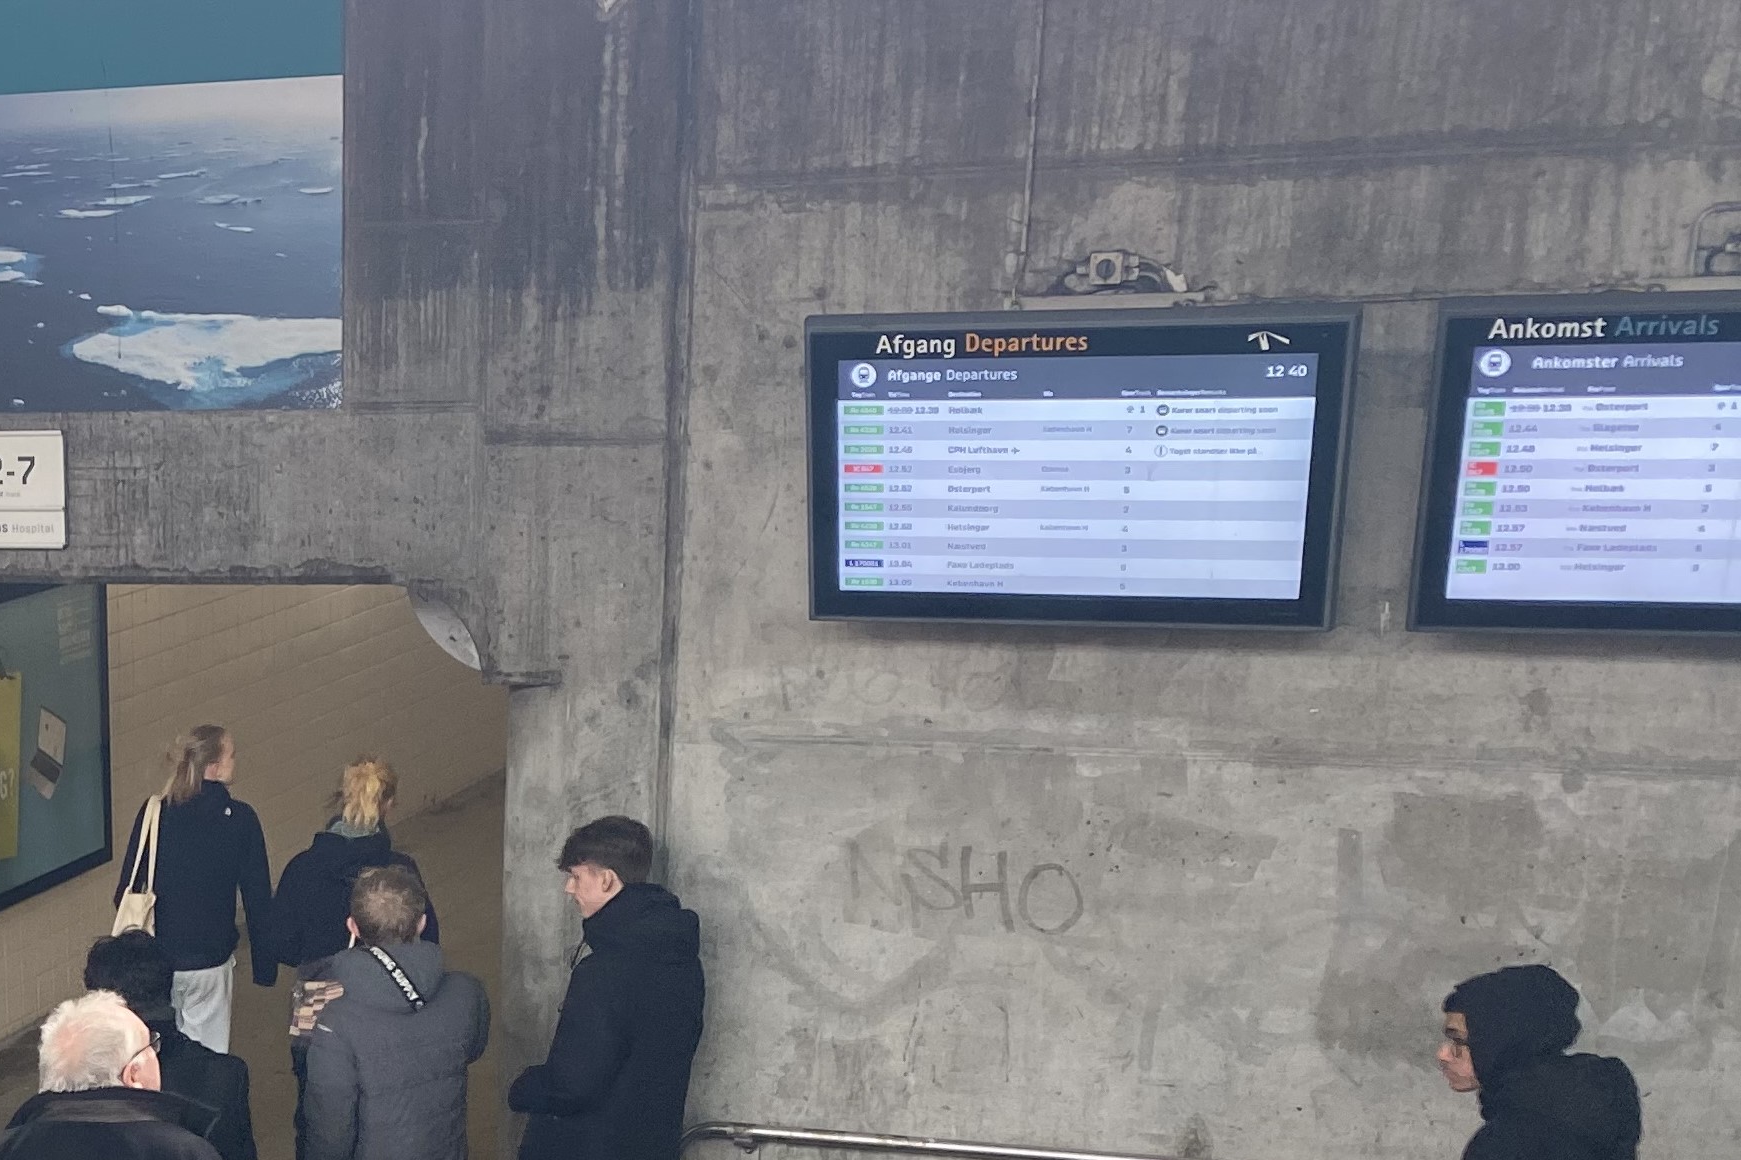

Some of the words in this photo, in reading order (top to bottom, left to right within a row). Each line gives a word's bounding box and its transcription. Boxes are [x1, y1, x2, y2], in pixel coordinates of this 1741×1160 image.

[1488, 317, 1607, 340] Ankomst
[1615, 315, 1720, 337] Arrivals
[876, 334, 956, 359] Afgang
[965, 333, 1089, 357] Departures
[1532, 356, 1618, 369] Ankomster
[1623, 354, 1684, 368] Arrivals
[946, 368, 1018, 382] Departures
[948, 465, 981, 475] Esbjerg
[12, 523, 54, 534] Hospital
